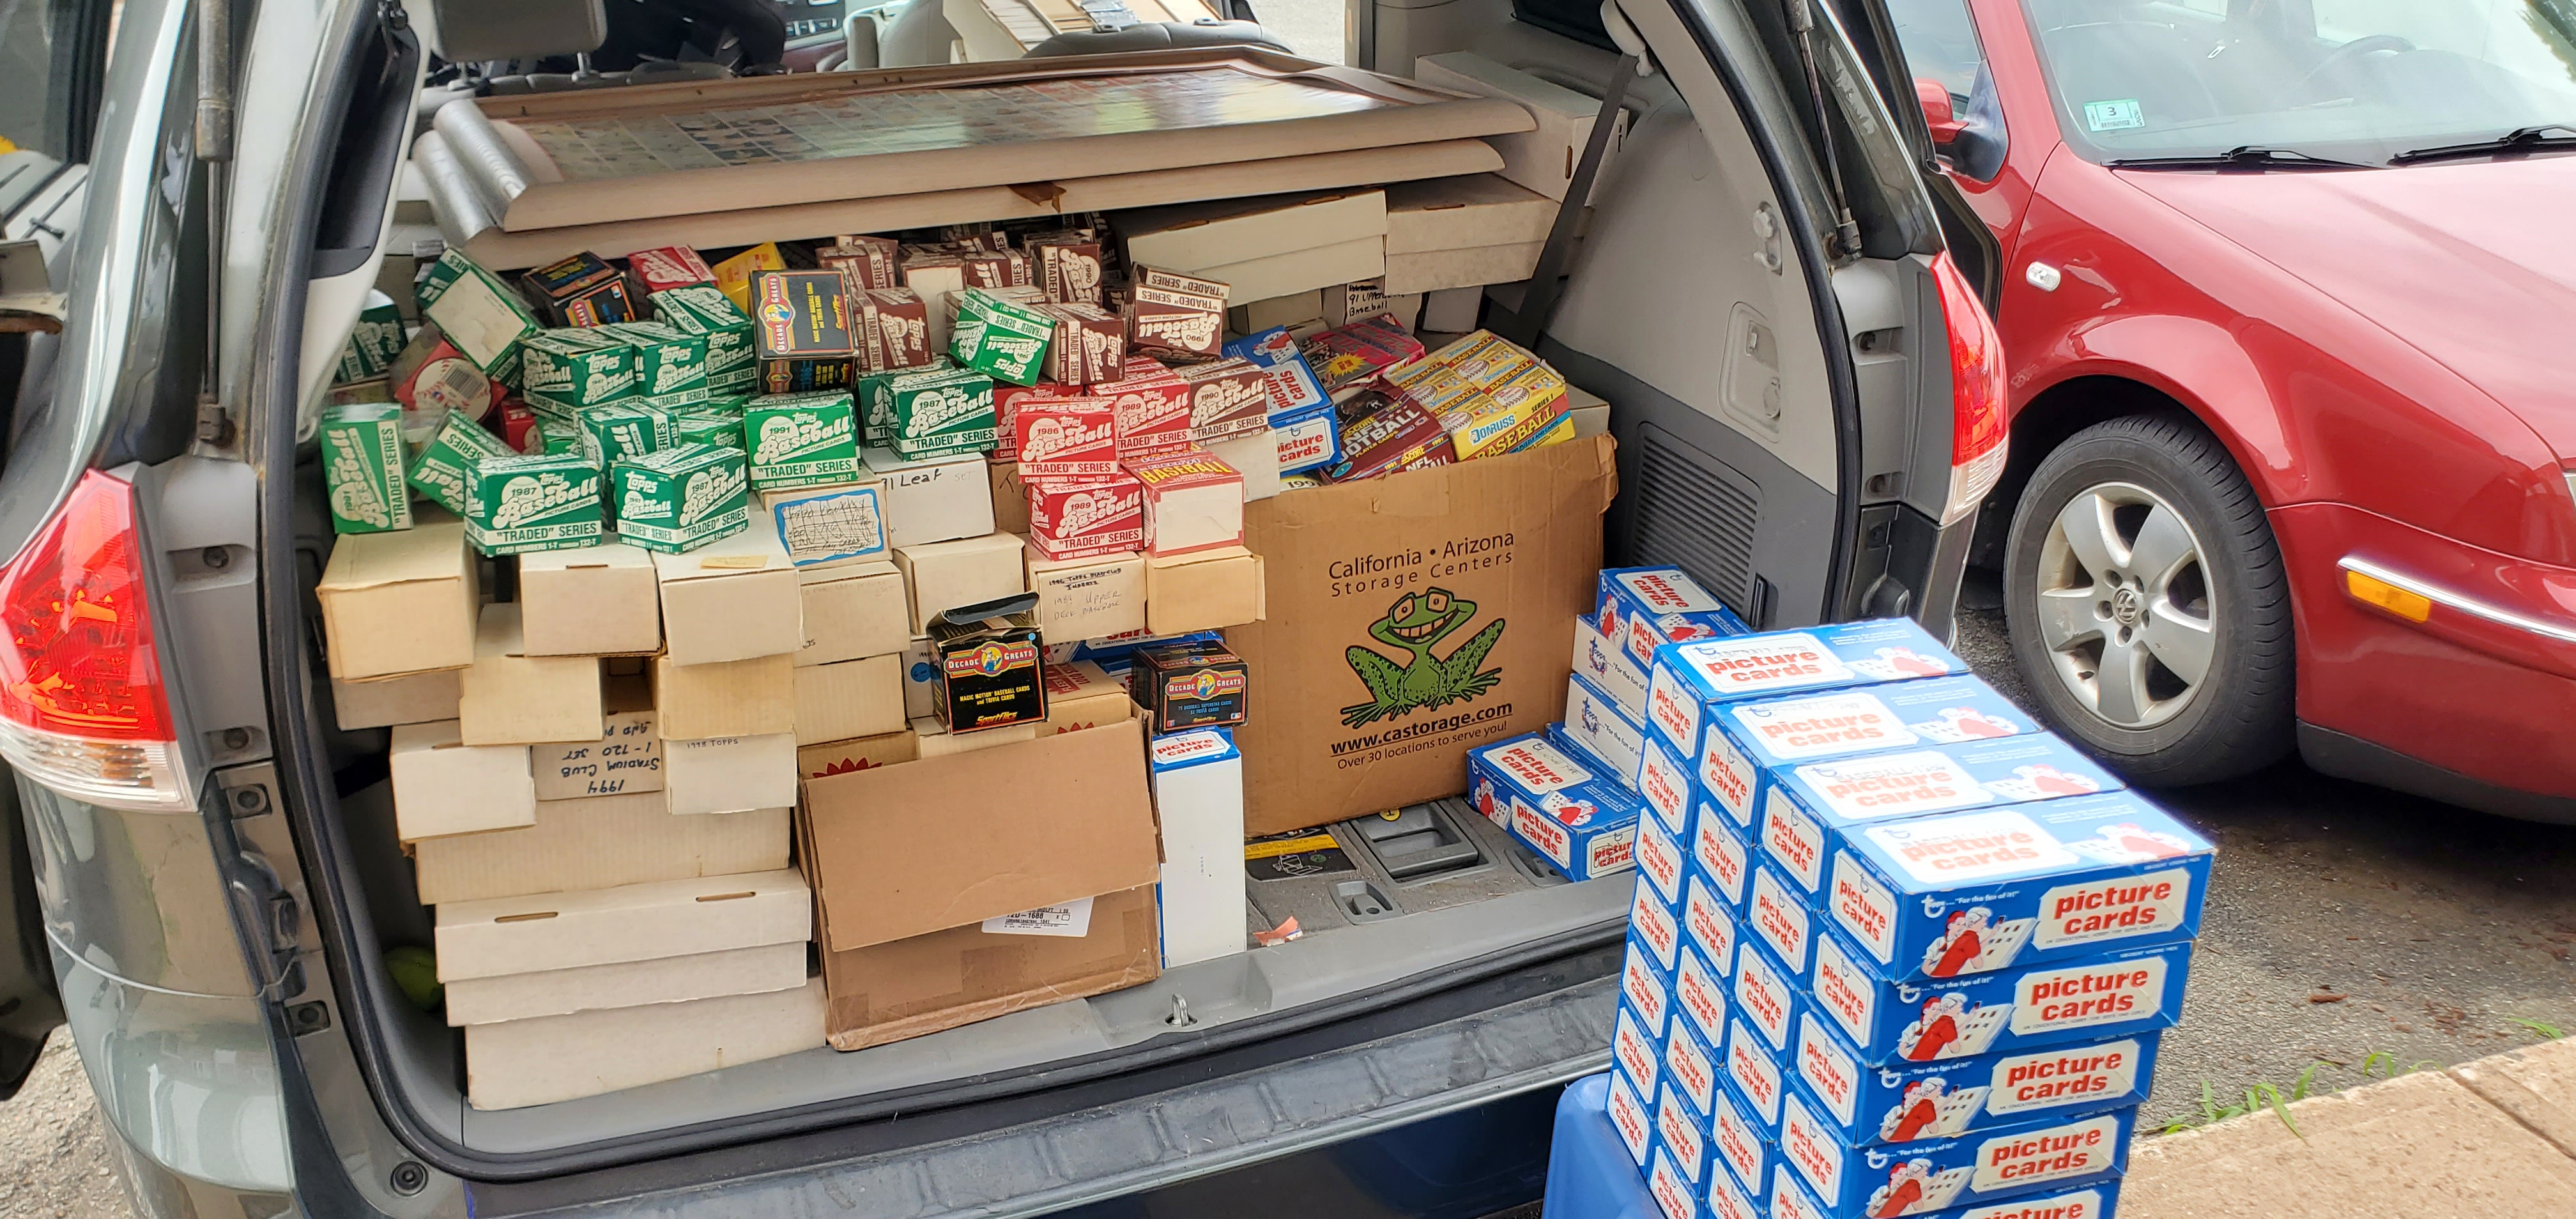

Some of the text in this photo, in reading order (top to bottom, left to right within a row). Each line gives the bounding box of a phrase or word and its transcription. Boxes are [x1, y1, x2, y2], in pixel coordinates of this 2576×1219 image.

[1142, 290, 1217, 310] "TRADED" SERIES
[1151, 275, 1224, 297] "TRADED" SERIES
[770, 278, 784, 350] DECADE GREATS
[1280, 370, 1306, 401] cards
[1490, 360, 1533, 390] BASEBALL
[1190, 378, 1264, 427] Baseball
[1201, 392, 1219, 401] 1990
[906, 388, 993, 438] Baseball
[1192, 415, 1264, 438] "TRADED" SERIES
[753, 416, 851, 464] Baseball
[769, 425, 791, 434] 1991
[910, 429, 994, 449] "TRADED" SERIES
[1022, 422, 1112, 462] Baseball
[1158, 431, 1187, 443] SERIES
[1344, 418, 1388, 445] NFL
[1432, 437, 1444, 447] 1991
[1470, 415, 1515, 444] DONRUSS
[1535, 430, 1545, 439] AND
[1279, 445, 1321, 463] cards
[1356, 442, 1377, 457] PLAYER
[381, 427, 406, 524] "TRADED" SERIES
[759, 461, 852, 479] "TRADED" SERIES
[901, 468, 942, 487] Leaf
[1025, 463, 1110, 473] "TRADED" SERIES
[1138, 461, 1233, 484] BASEBALL
[511, 487, 537, 497] 1987
[680, 463, 746, 526] Baseball
[691, 482, 709, 494] 1987
[492, 476, 598, 529] Baseball
[1055, 491, 1140, 539] Baseball
[1070, 502, 1091, 510] 1989
[496, 523, 597, 542] "TRADED" SERIES
[683, 509, 746, 541] "TRADED" SERIES
[1059, 530, 1139, 549] "TRADED" SERIES
[1329, 532, 1514, 579] California Arizona
[1331, 551, 1513, 597] Storage Centers
[1632, 578, 1670, 606] cards
[1641, 574, 1690, 610] picture
[948, 650, 1032, 669] DECADE GREATS
[1705, 650, 1821, 675] picture
[1729, 663, 1823, 682] cards
[994, 687, 1015, 696] BASEBALL
[1216, 678, 1241, 687] GREATS
[976, 712, 1018, 725] Sportflics
[1655, 686, 1690, 730] picture
[1331, 702, 1513, 755] www.castorage.com
[1657, 704, 1686, 741] cards
[562, 749, 588, 760] SET
[709, 738, 739, 747] TOPPS
[1156, 739, 1213, 755] picture
[1338, 721, 1507, 769] Over 30 locations to serve you!
[561, 758, 659, 778] STADIUM CLUB
[1501, 756, 1545, 786] cards
[1506, 747, 1563, 785] picture
[588, 779, 624, 794] 1994
[1647, 761, 1680, 808] picture
[1516, 803, 1563, 845] picture
[1522, 822, 1560, 856] cards
[2053, 880, 2172, 919] picture
[2062, 903, 2157, 937] cards
[2030, 967, 2149, 1006] picture
[2042, 991, 2134, 1022] cards
[2005, 1052, 2122, 1087] picture
[2016, 1075, 2108, 1103] cards
[1989, 1128, 2102, 1167] picture
[2000, 1149, 2089, 1179] cards
